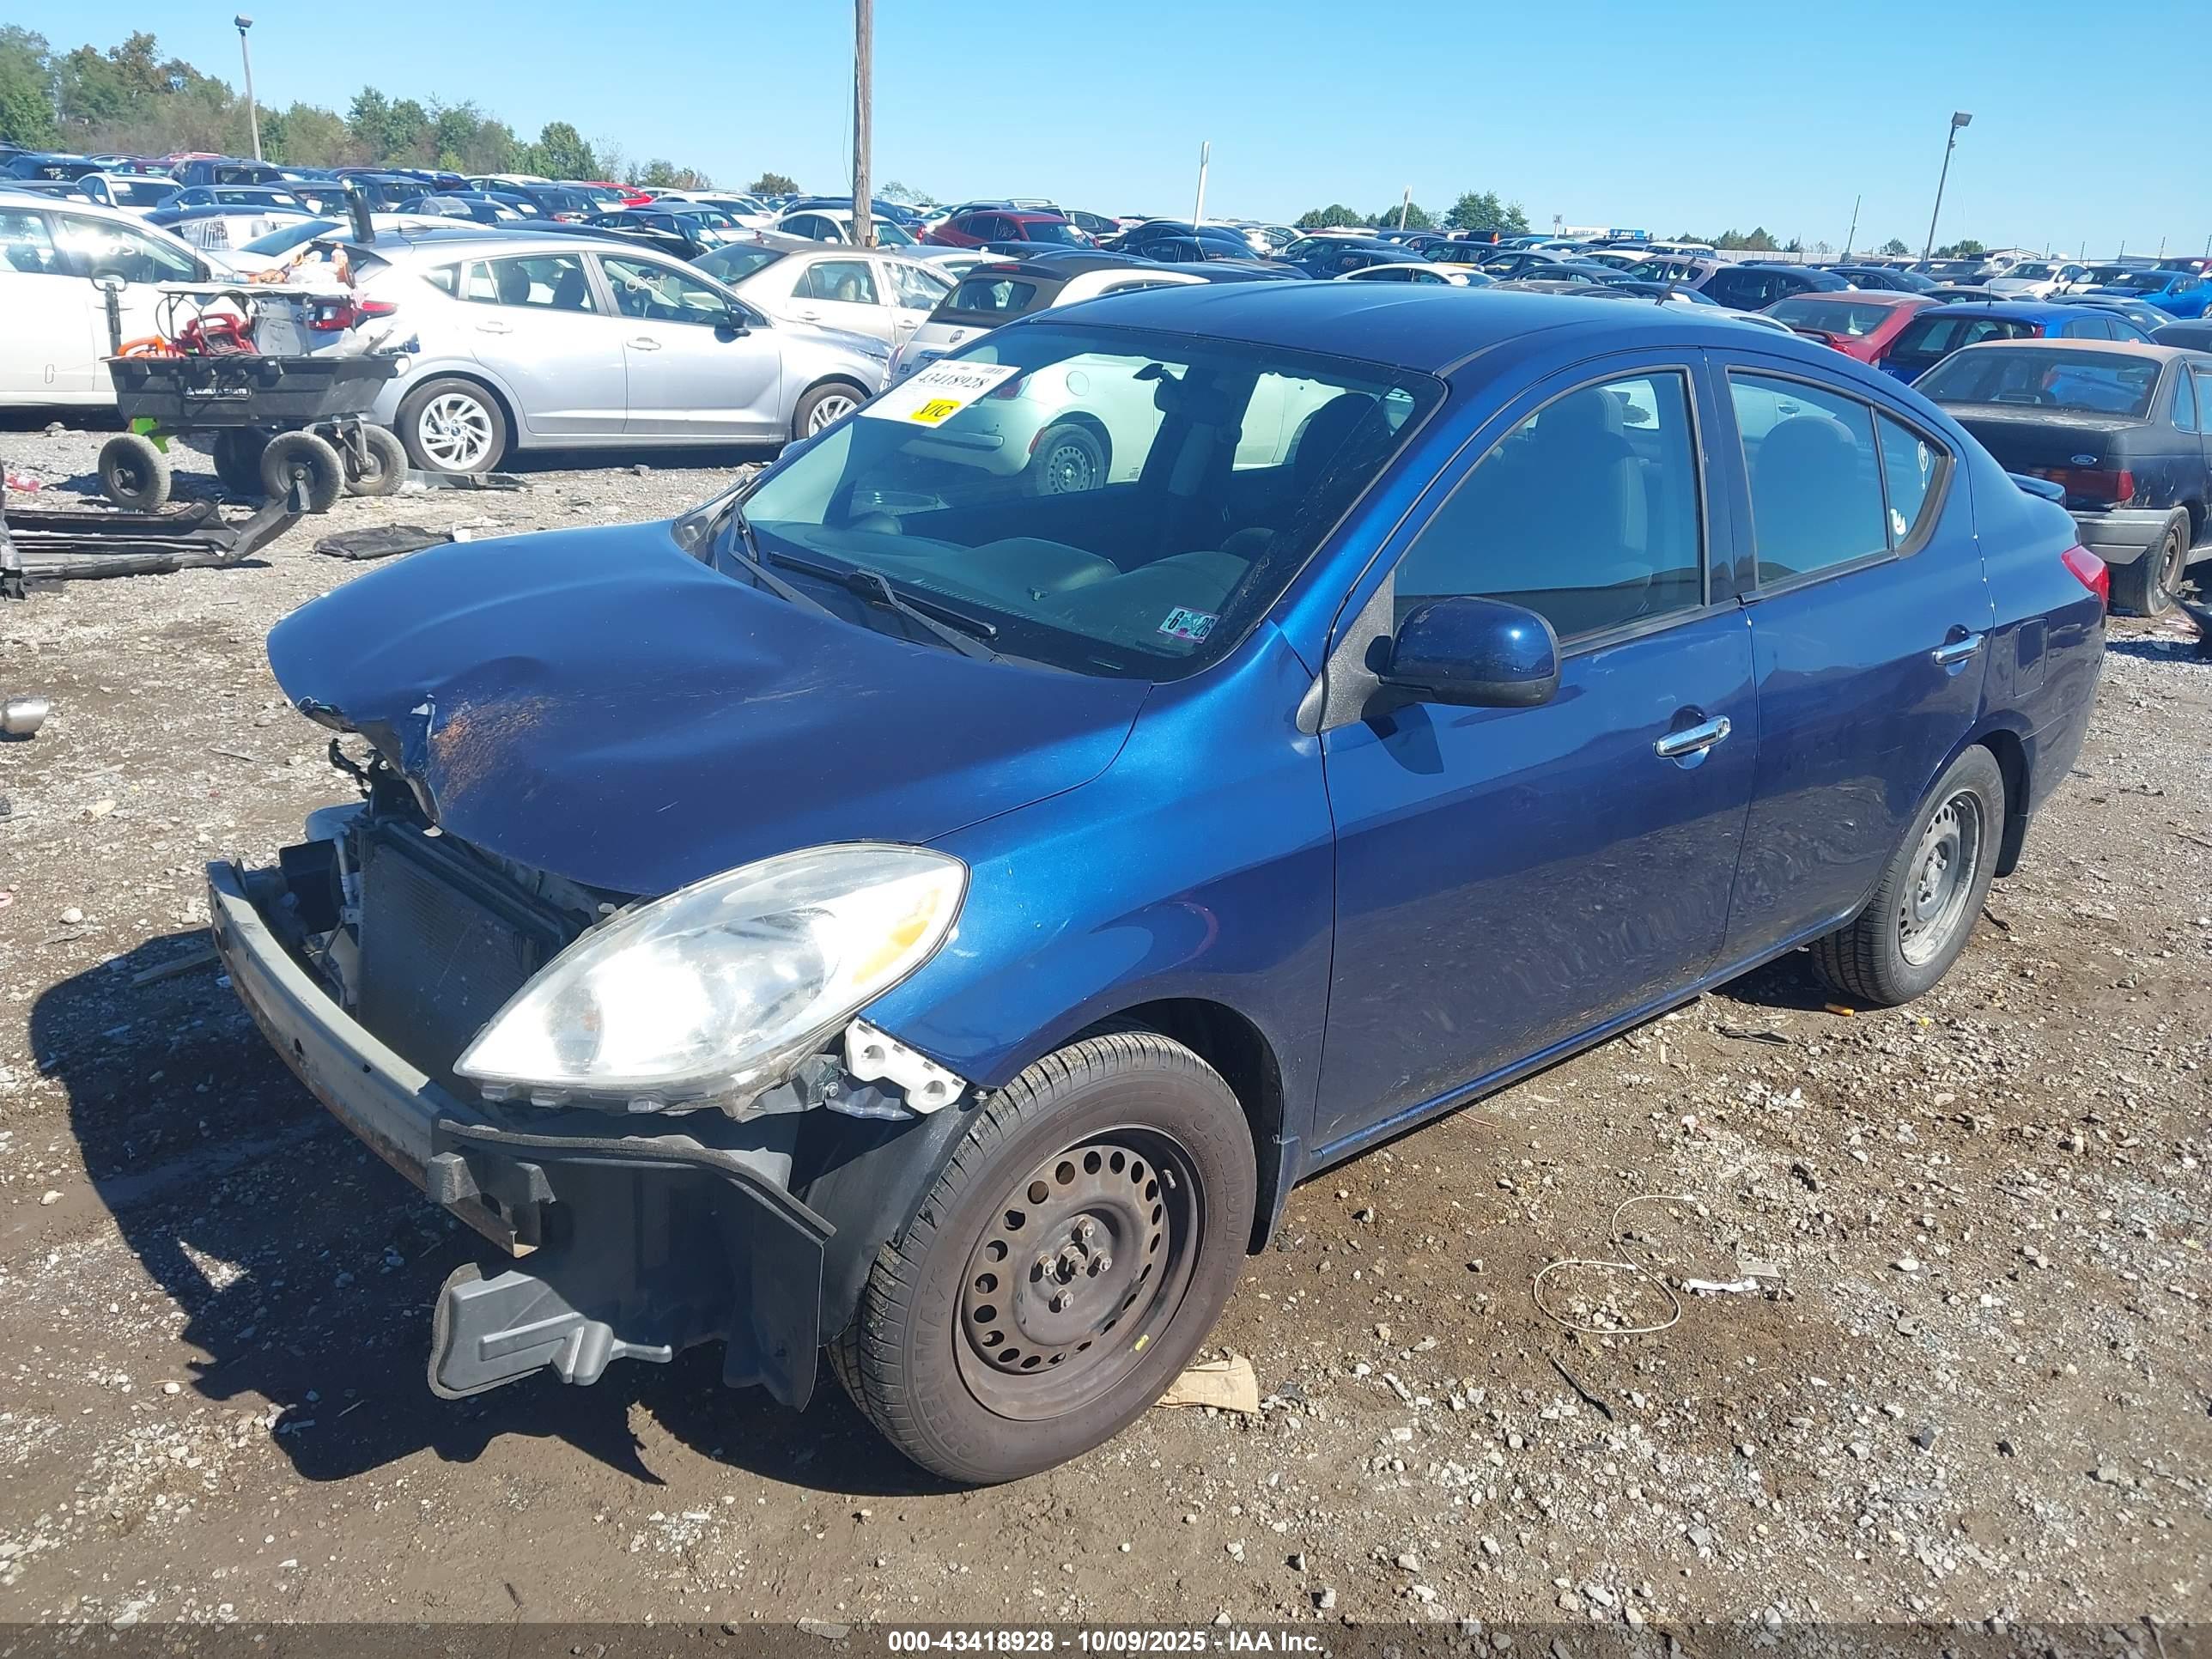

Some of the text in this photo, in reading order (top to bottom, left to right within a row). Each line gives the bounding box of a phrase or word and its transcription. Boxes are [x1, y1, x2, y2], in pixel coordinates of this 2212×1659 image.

[918, 373, 990, 389] 43418928
[921, 402, 954, 417] VIC
[1194, 617, 1216, 637] 26
